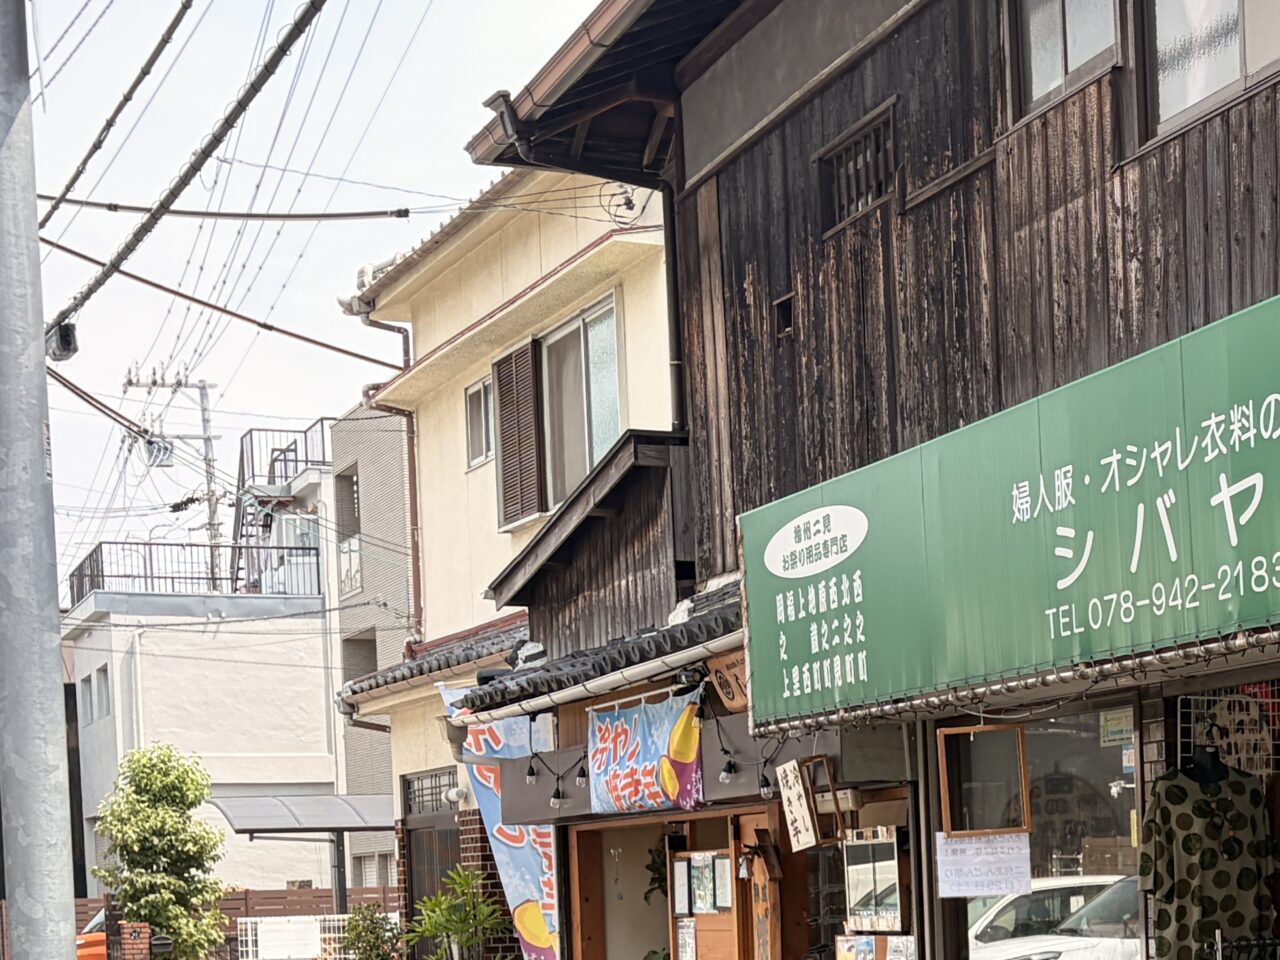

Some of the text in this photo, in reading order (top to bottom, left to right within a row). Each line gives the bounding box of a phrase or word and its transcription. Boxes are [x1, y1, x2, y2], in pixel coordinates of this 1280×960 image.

[782, 534, 848, 572] お祭り用品専門店
[1054, 472, 1265, 591] シバヤ
[852, 569, 868, 683] 西之町
